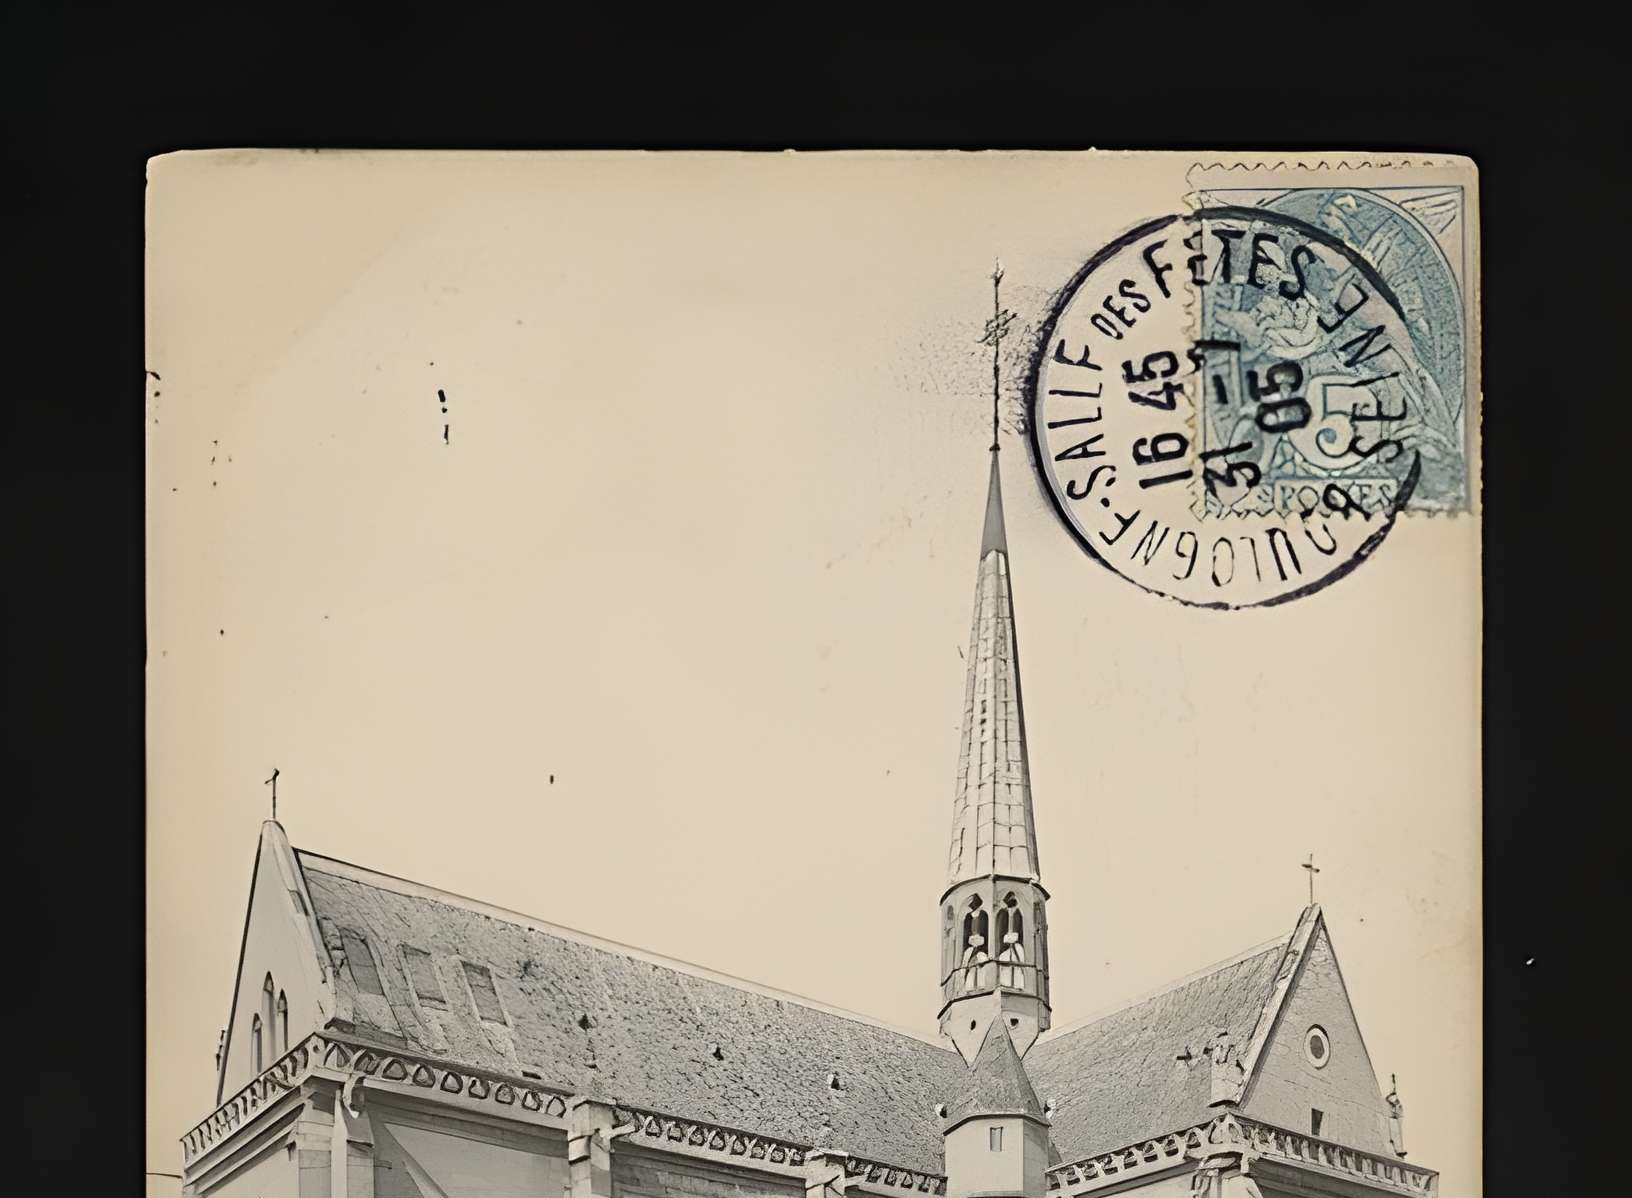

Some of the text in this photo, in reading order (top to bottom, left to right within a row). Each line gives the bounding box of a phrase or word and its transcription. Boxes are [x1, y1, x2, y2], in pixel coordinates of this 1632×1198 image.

[1121, 350, 1194, 490] 16 45
[1248, 360, 1313, 433] 05
